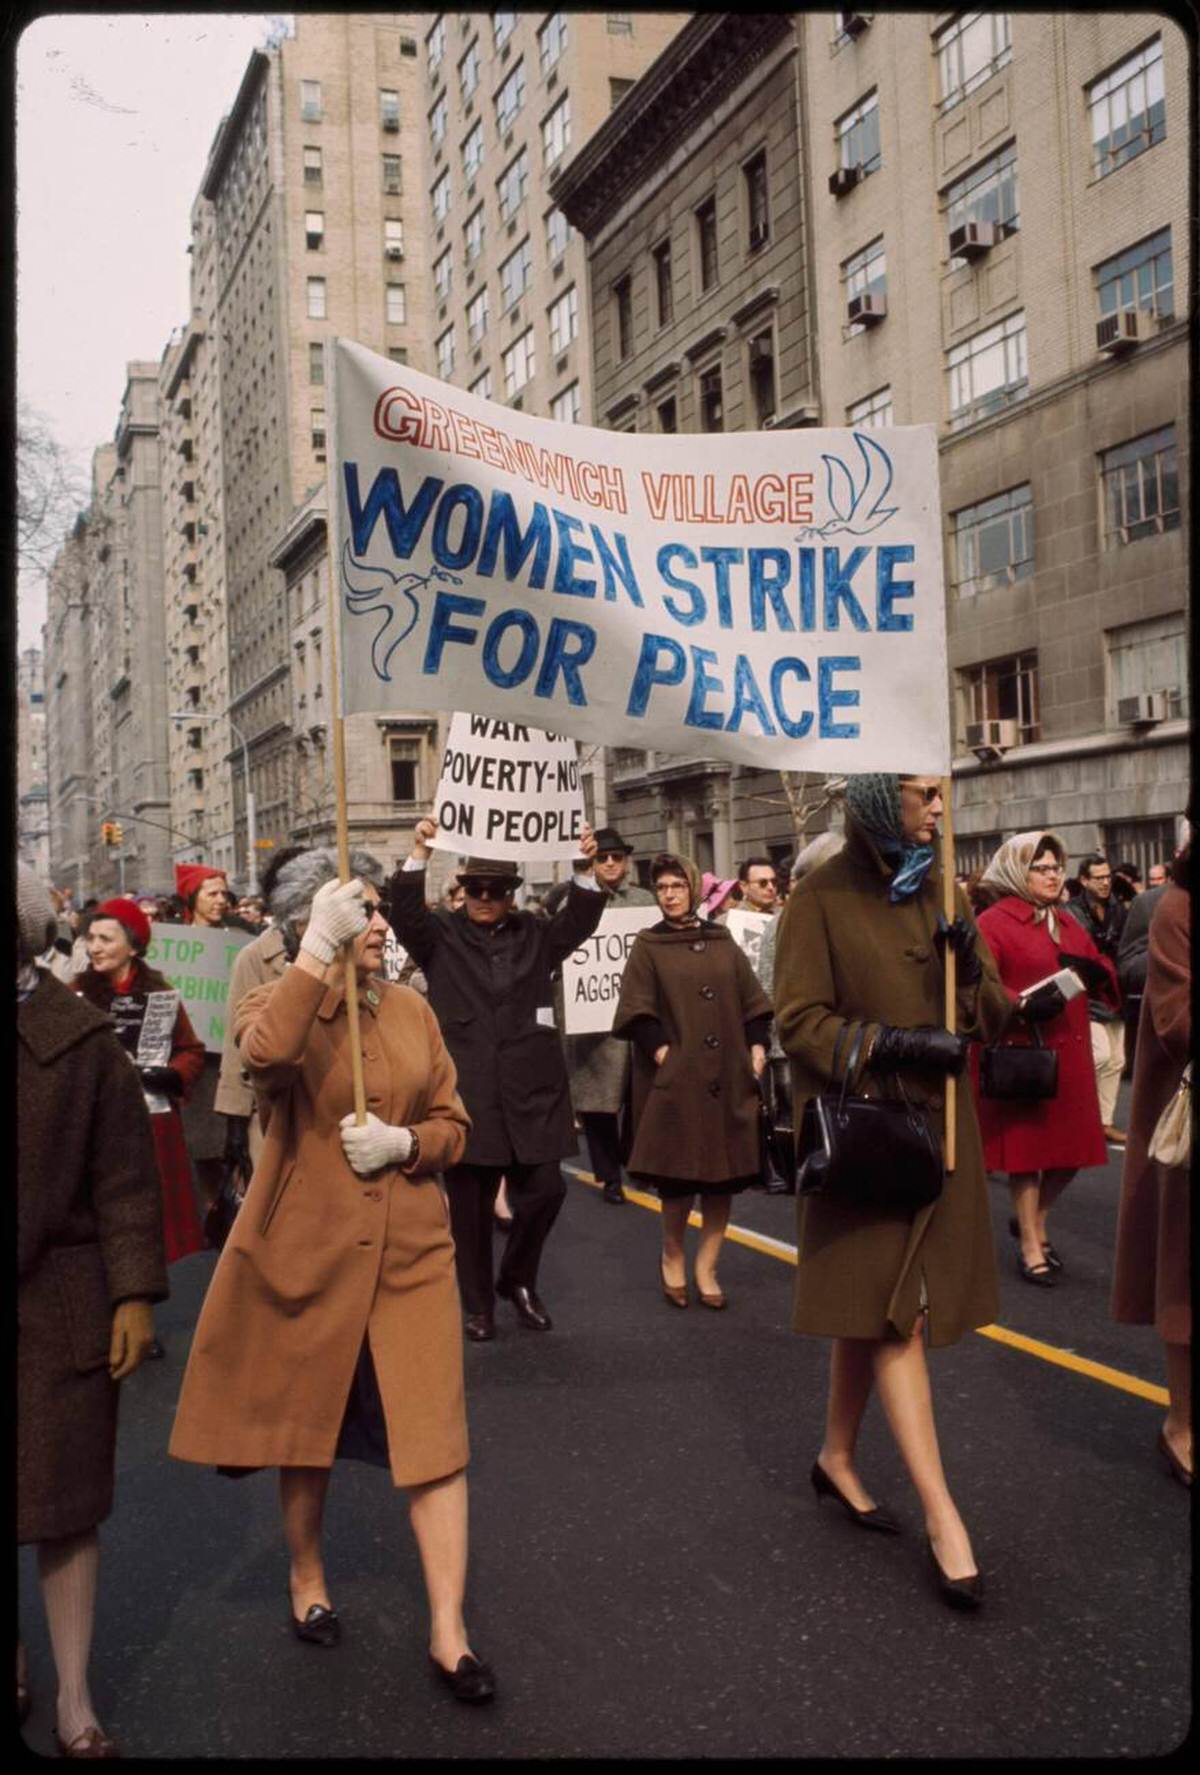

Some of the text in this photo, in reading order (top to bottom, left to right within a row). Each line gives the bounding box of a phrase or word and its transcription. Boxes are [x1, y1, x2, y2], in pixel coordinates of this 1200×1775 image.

[373, 386, 814, 525] GREENWICH VILLAGE
[344, 461, 915, 633] WOMEN STRIKE
[423, 593, 861, 740] FOR PEACE
[441, 749, 581, 793] POVERTY-NO
[439, 801, 582, 843] ON PEOPLE
[148, 937, 204, 963] STOP
